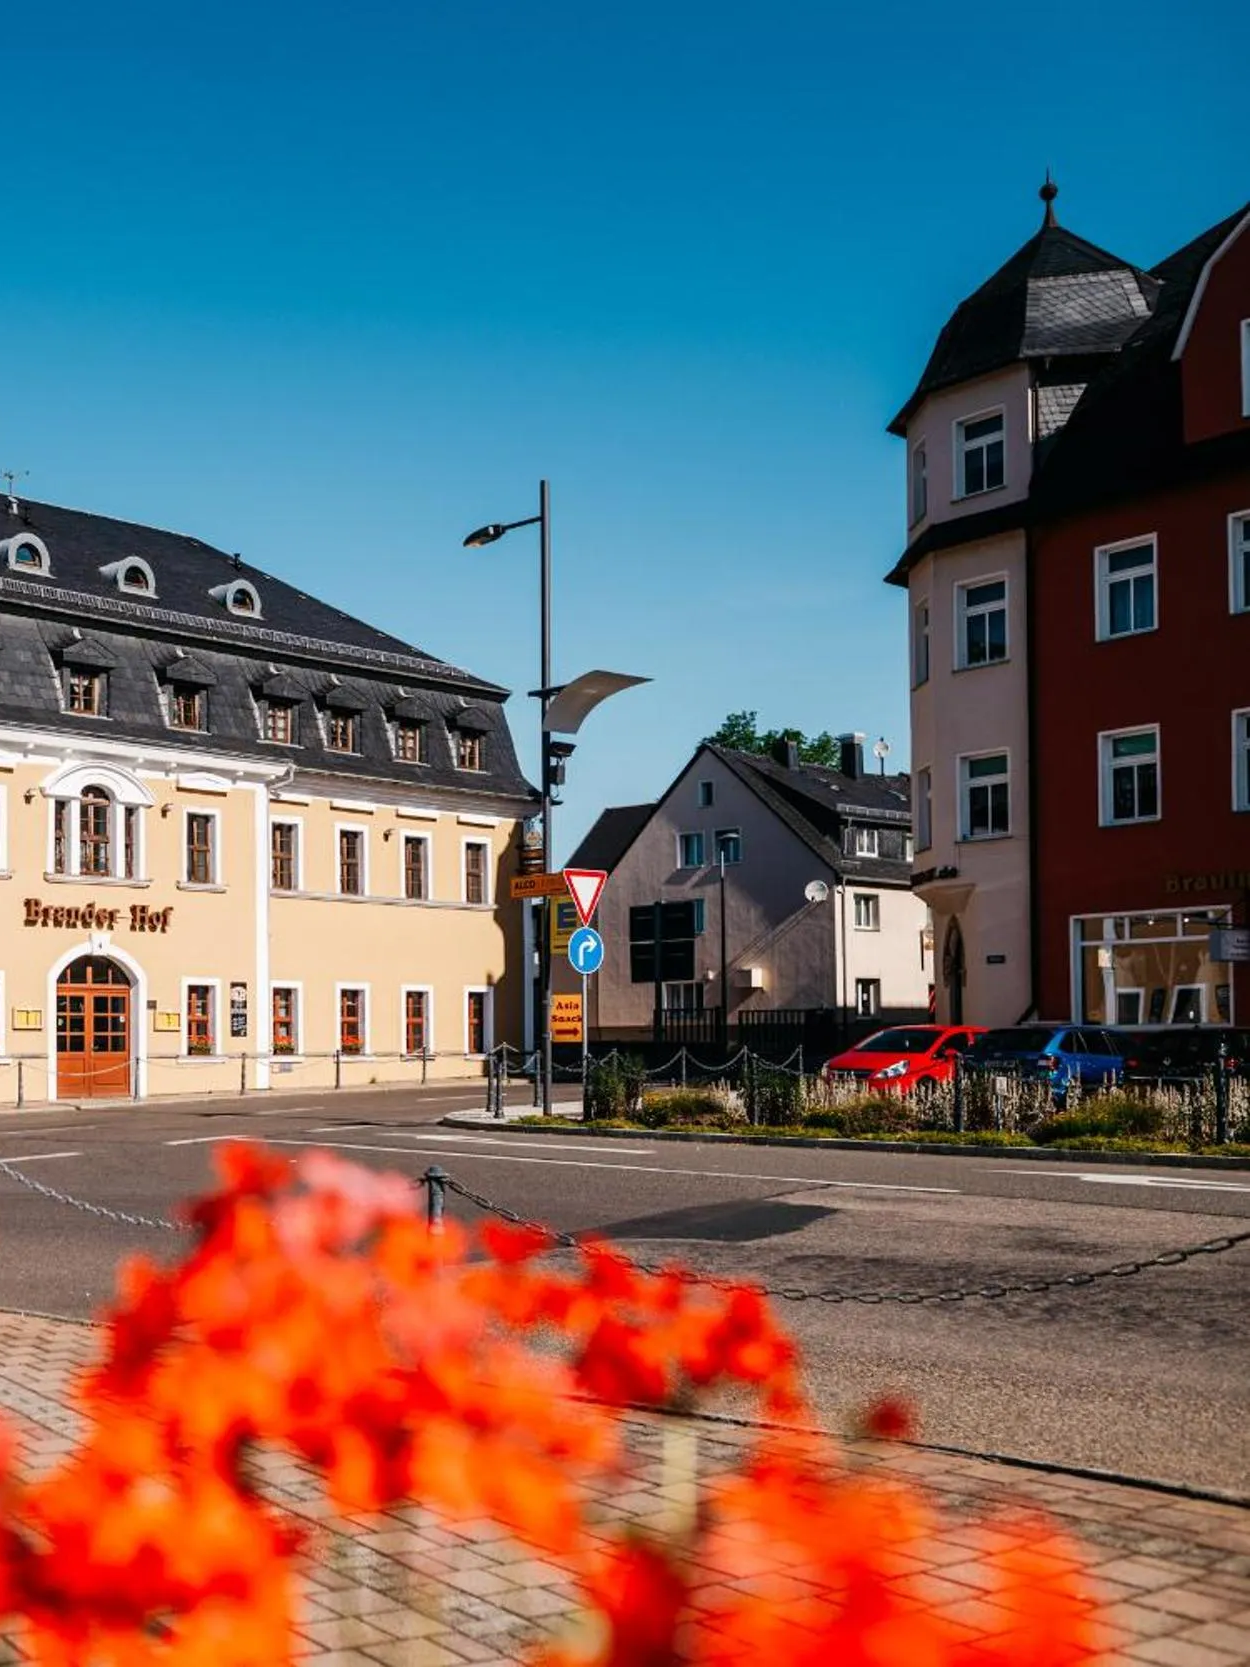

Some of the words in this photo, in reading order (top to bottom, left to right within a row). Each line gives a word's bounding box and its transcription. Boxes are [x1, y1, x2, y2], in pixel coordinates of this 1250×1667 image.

[23, 898, 120, 930] Brander
[129, 904, 174, 933] Hof
[556, 1001, 579, 1010] Asia
